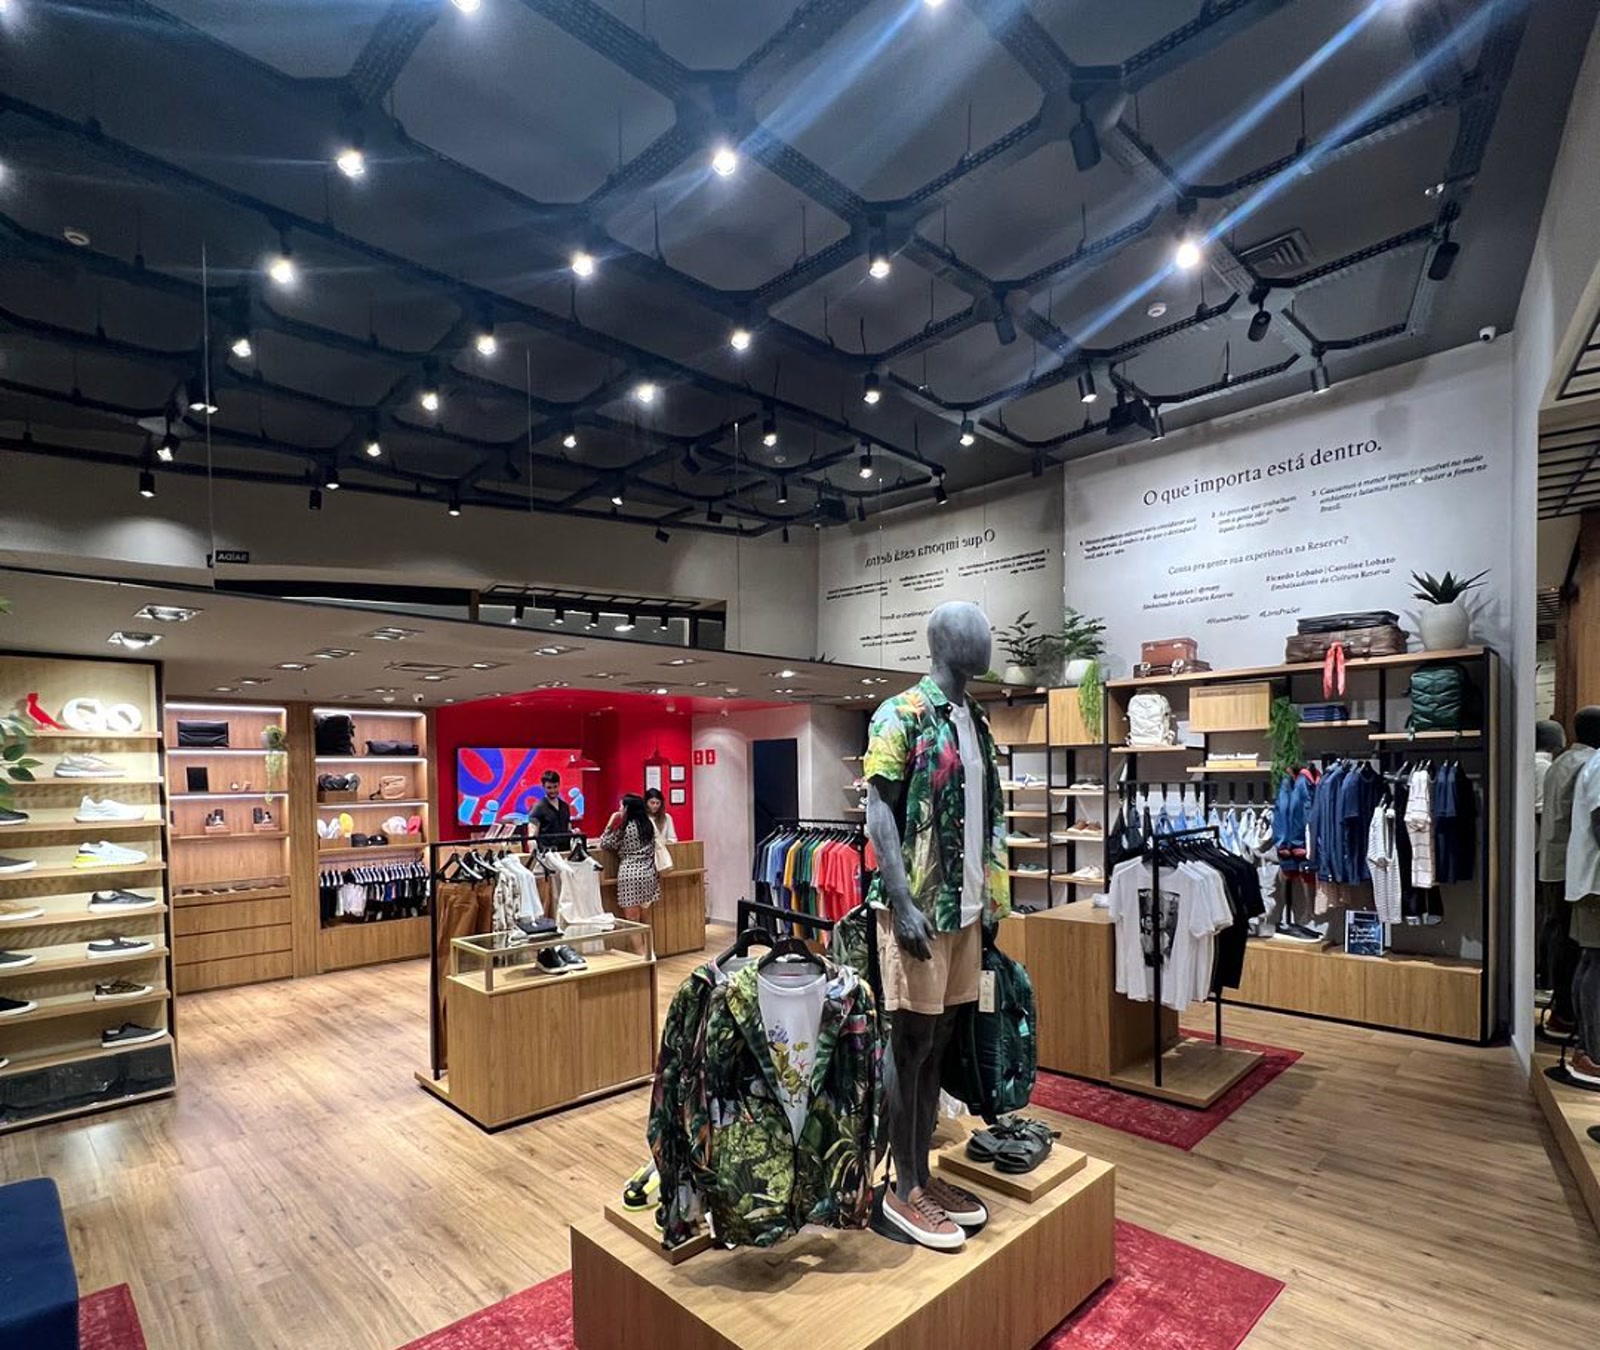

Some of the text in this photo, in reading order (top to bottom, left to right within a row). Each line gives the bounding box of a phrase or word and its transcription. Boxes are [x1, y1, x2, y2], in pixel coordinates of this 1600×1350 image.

[1143, 440, 1382, 506] O que importa está dentro.
